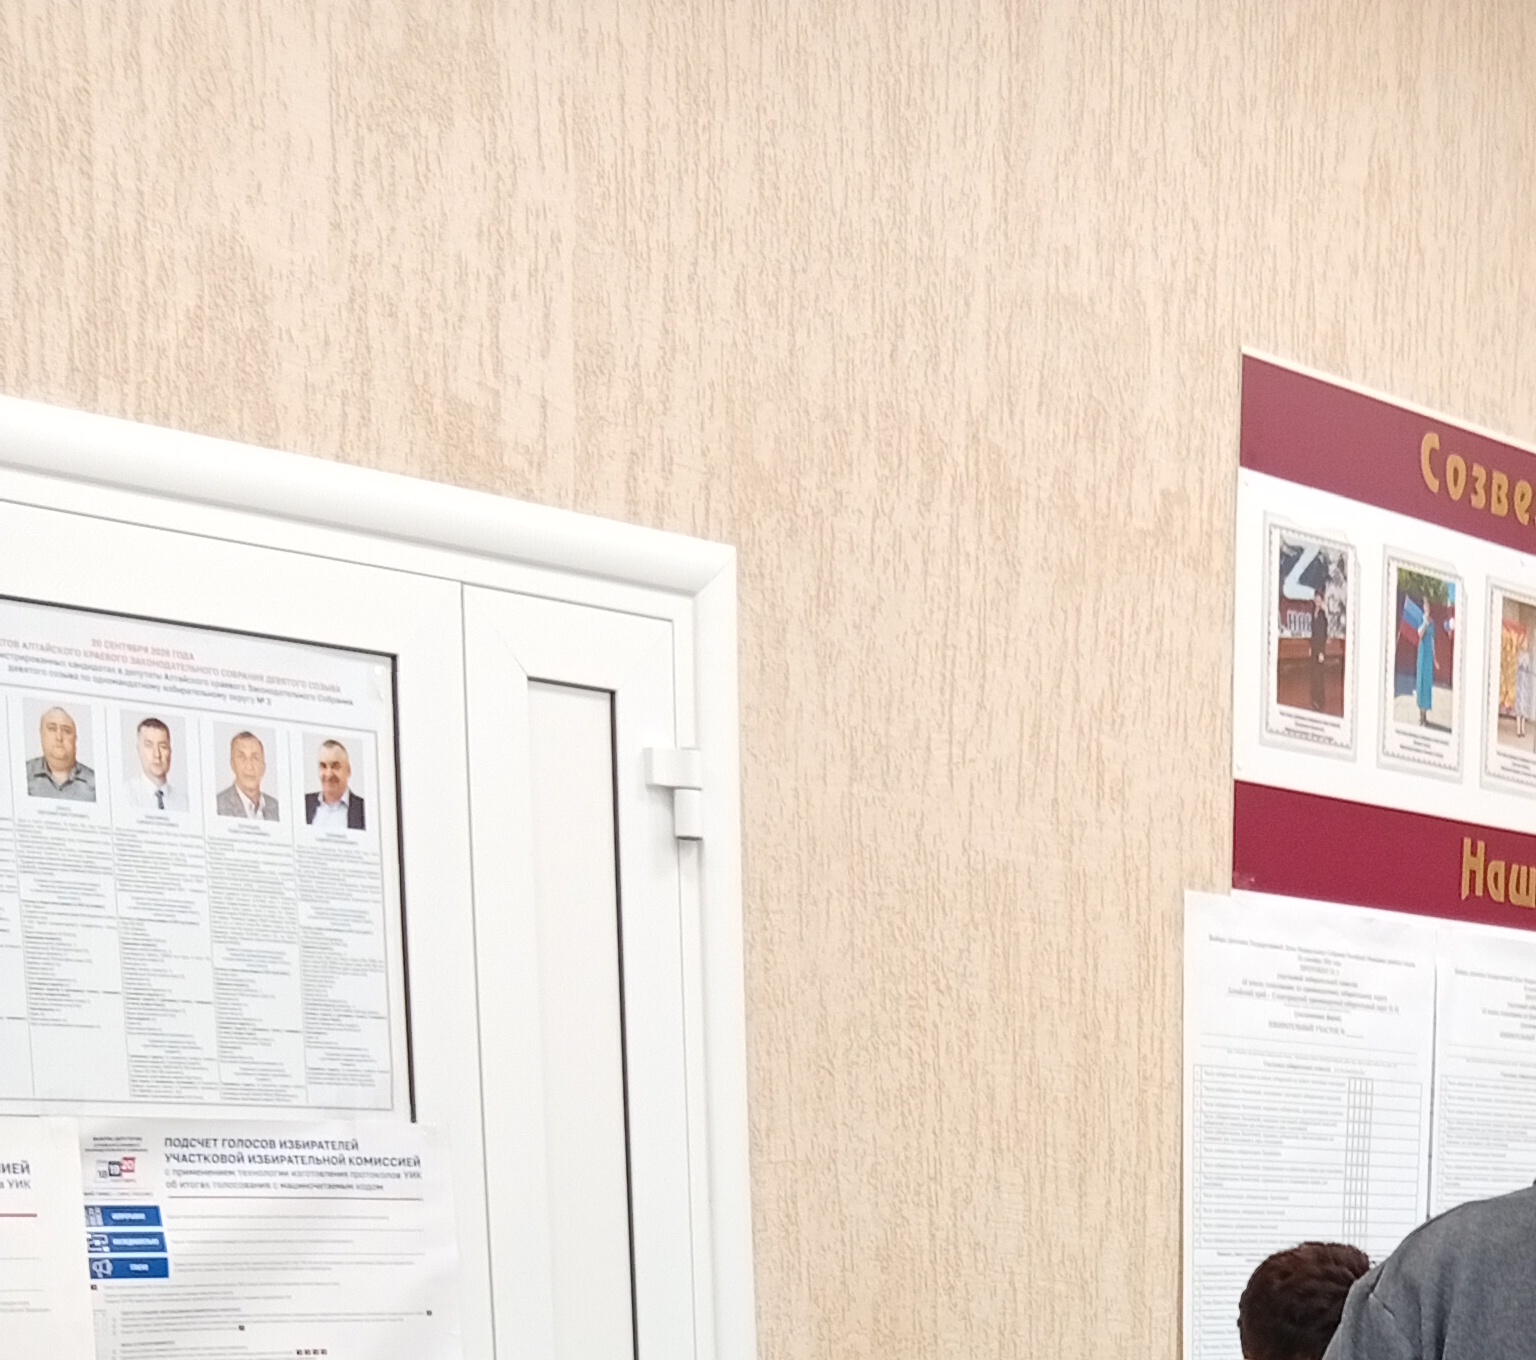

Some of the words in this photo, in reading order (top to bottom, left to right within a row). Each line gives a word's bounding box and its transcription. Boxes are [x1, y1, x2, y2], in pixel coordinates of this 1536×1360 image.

[164, 1137, 218, 1149] ПОДСЧЕТ
[221, 1138, 276, 1150] ГОЛОСОВ
[278, 1137, 359, 1151] ИЗБИРАТЕЛЕЙ
[164, 1151, 244, 1165] УЧАСТКОВОЙ
[247, 1152, 346, 1167] ИЗБИРАТЕЛЬНОЙ
[348, 1152, 421, 1168] КОМИССИЕЙ
